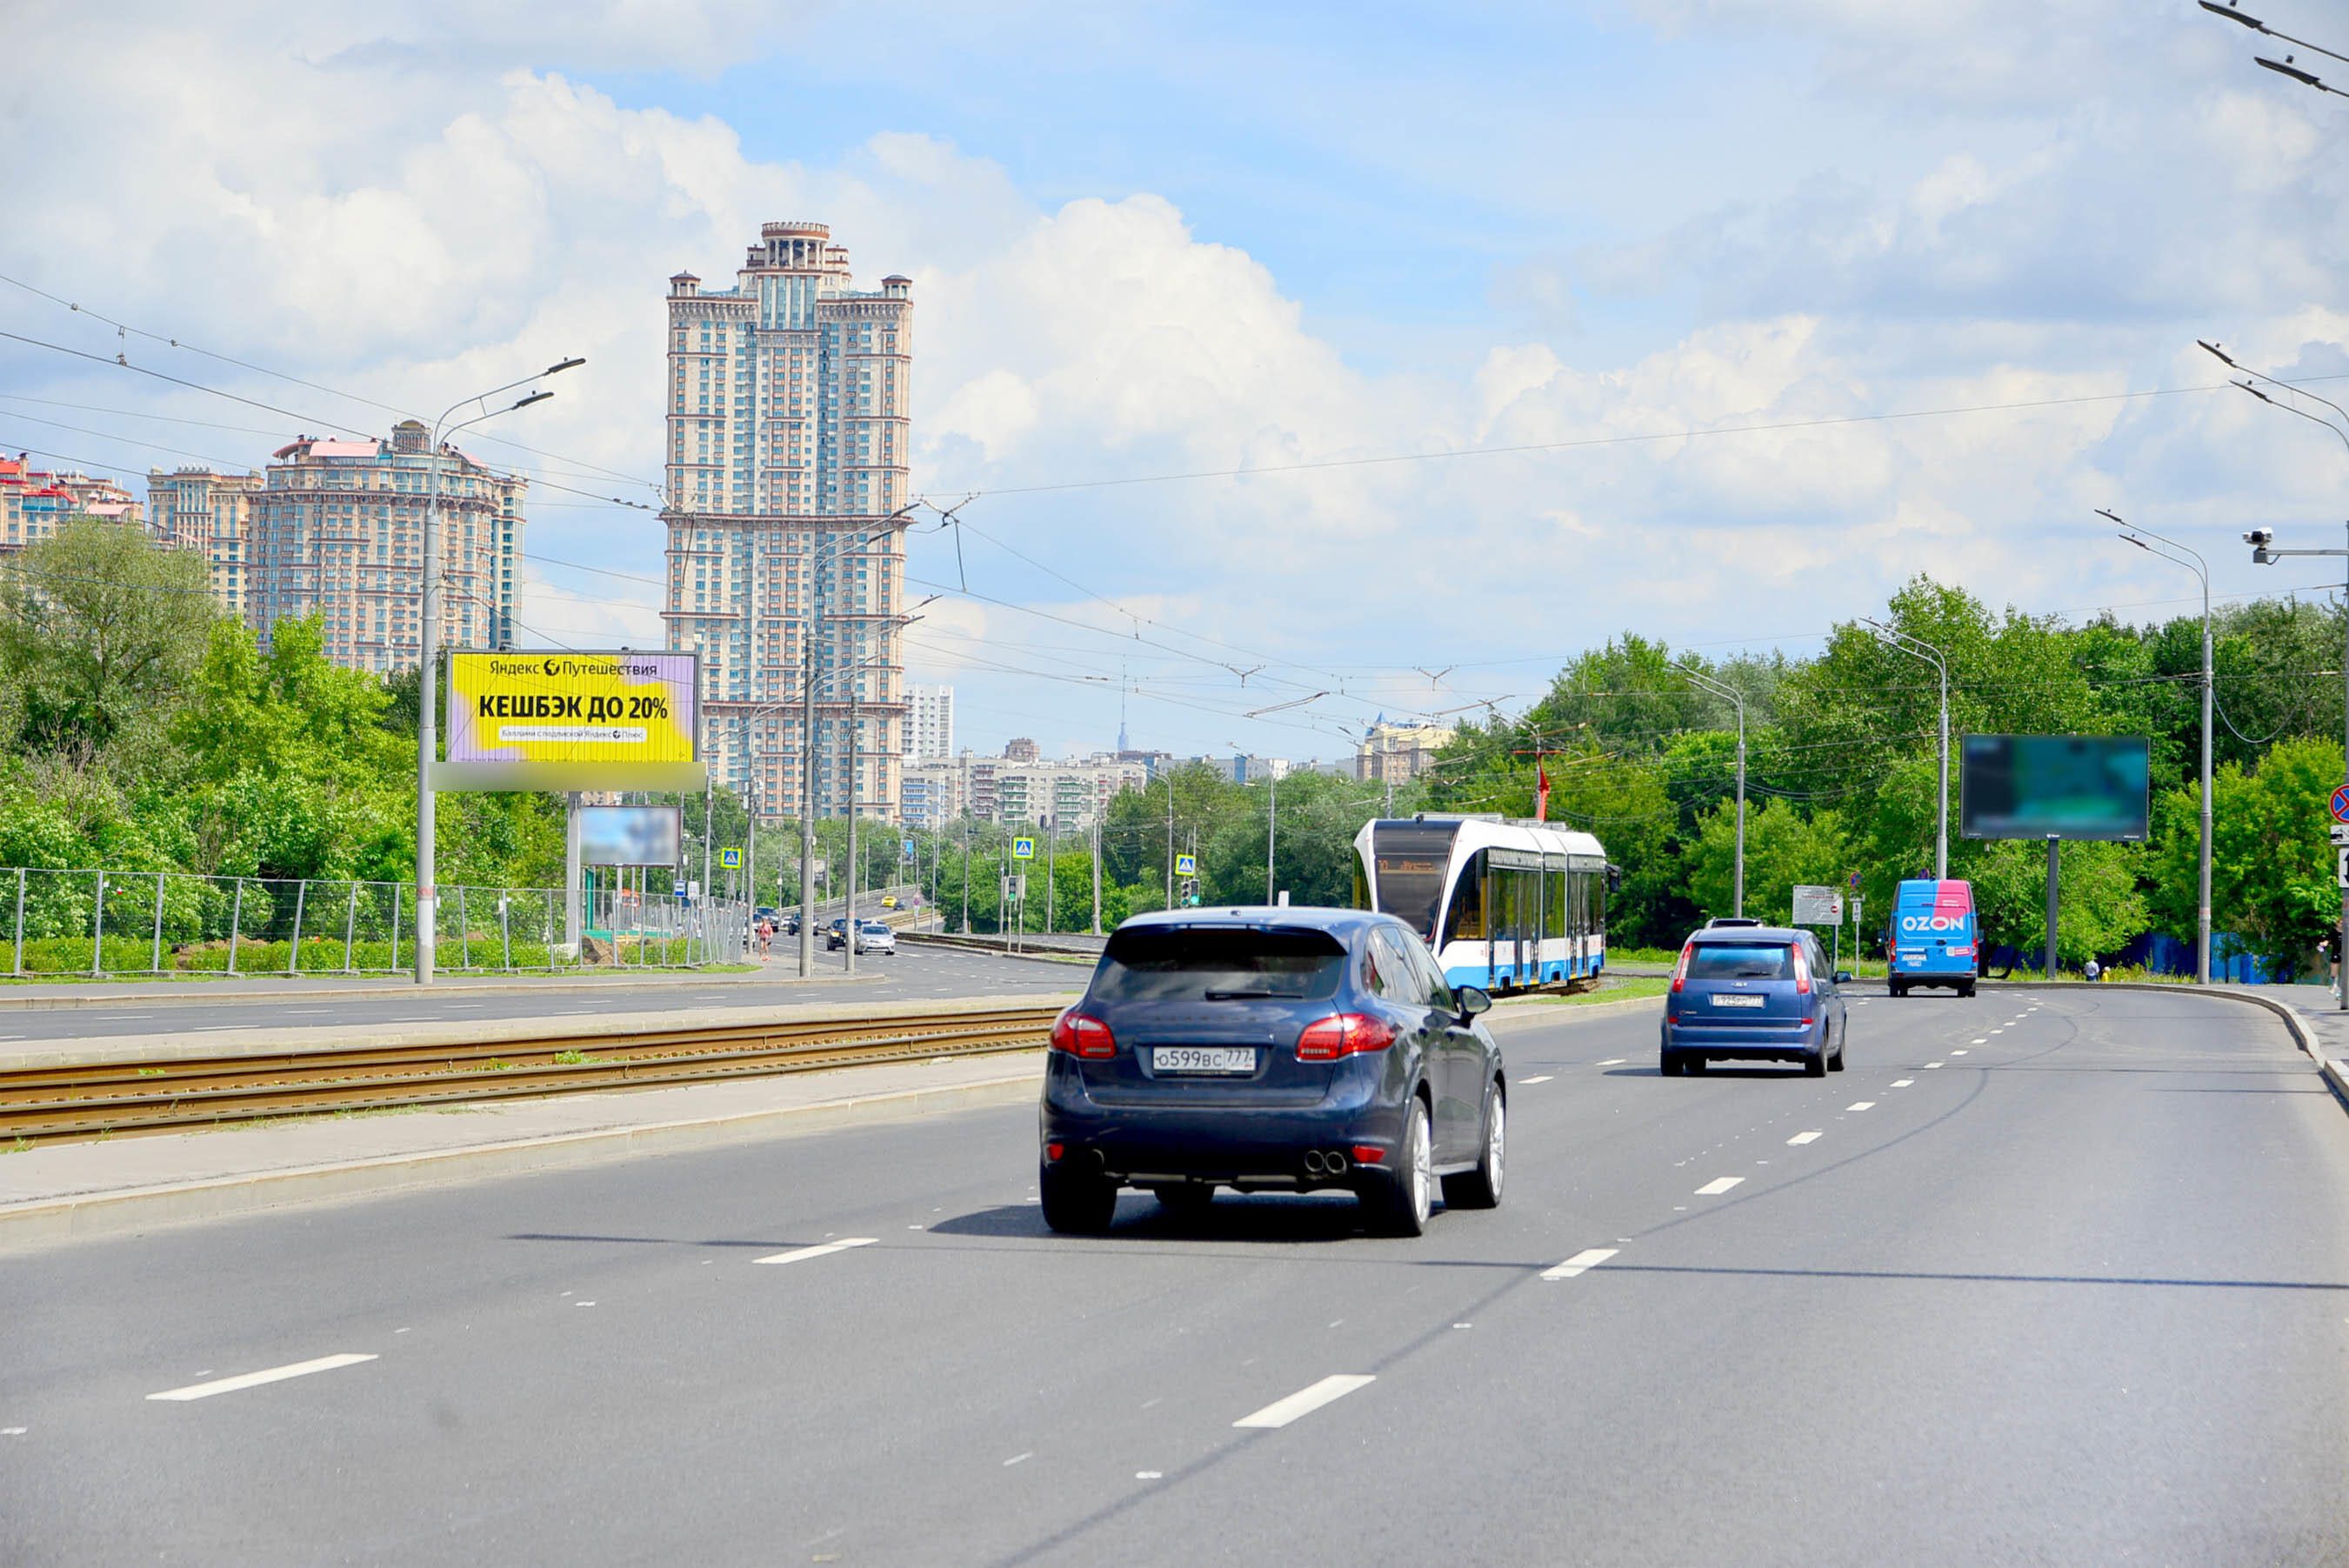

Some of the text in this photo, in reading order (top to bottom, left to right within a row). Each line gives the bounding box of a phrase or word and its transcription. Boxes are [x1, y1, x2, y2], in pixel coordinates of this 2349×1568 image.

[490, 660, 657, 677] Яндекс Путешествия
[479, 695, 668, 723] КЕШБЭК ДО 20%
[1902, 916, 1965, 931] OZON
[1226, 1050, 1251, 1063] 777
